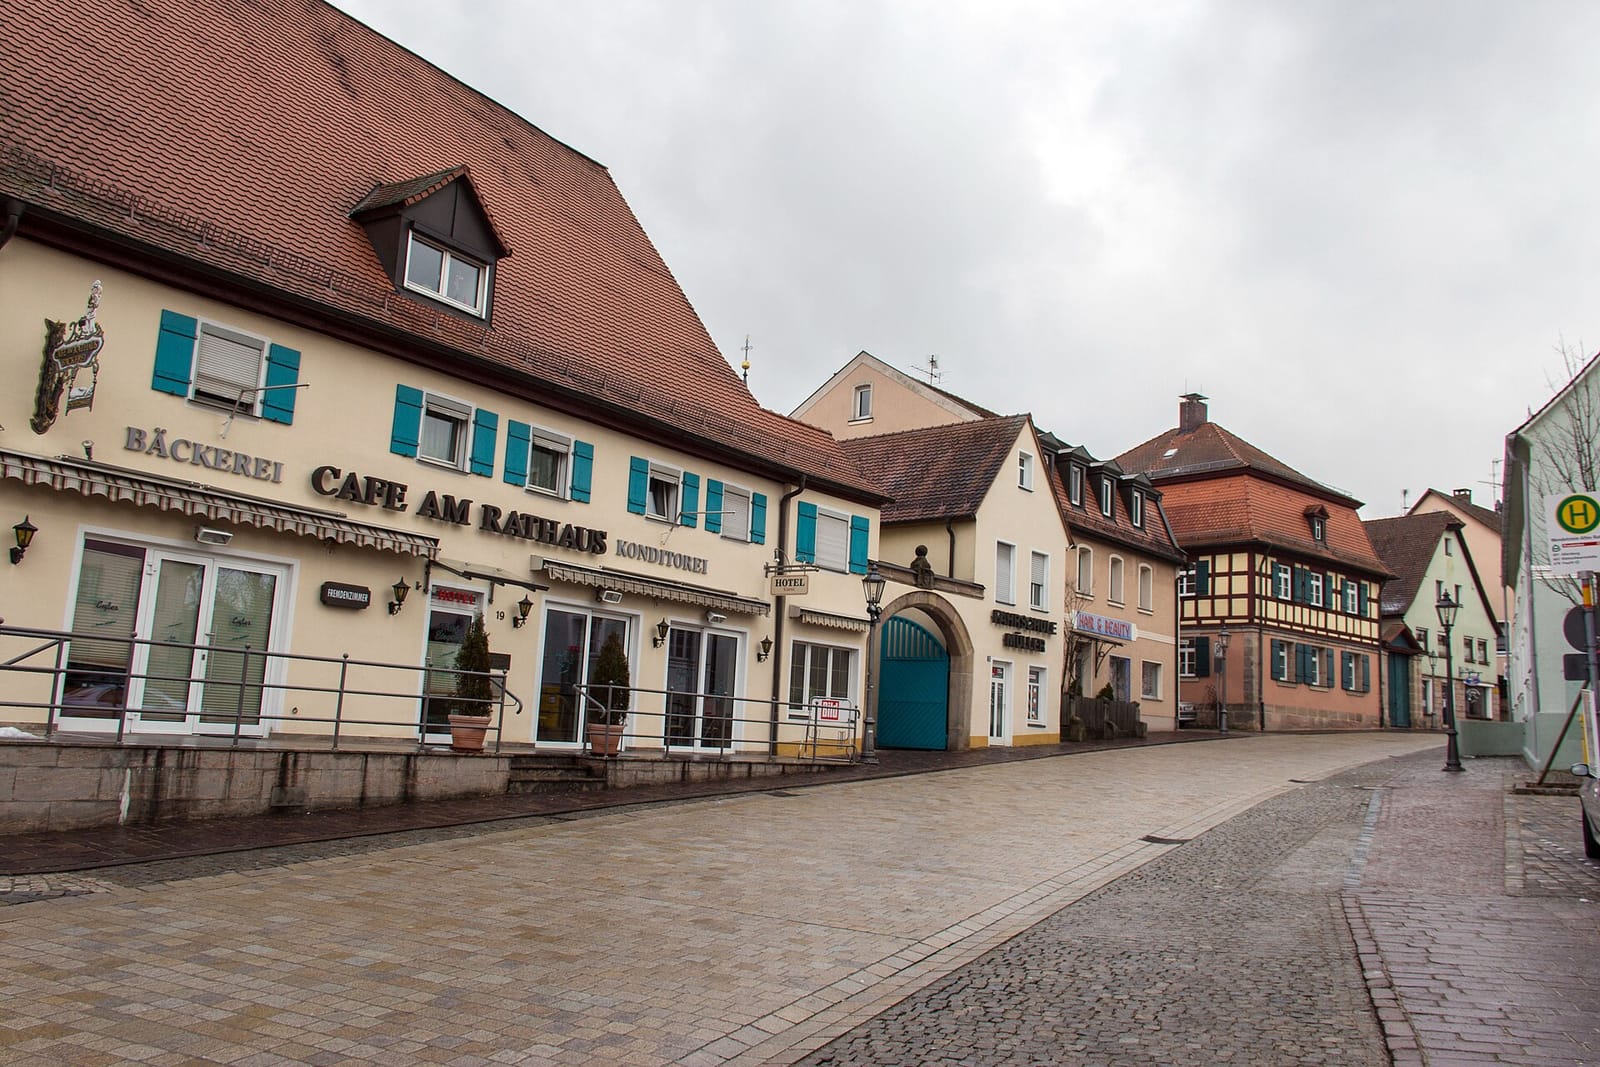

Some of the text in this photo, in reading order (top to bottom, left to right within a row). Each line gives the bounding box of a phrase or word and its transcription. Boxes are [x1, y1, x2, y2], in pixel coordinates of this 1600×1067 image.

[124, 426, 284, 484] BÄCKEREI
[311, 465, 607, 555] CAFE AM RATHAUS
[1569, 503, 1589, 526] H
[616, 539, 709, 575] KONDITOREI
[775, 578, 805, 587] HOTEL
[327, 588, 369, 602] FREMDENZIMMER
[437, 589, 476, 606] HOTEL
[496, 610, 505, 621] 19
[990, 609, 1058, 635] FAHRSCHULE
[1079, 613, 1095, 630] HAIR
[1104, 620, 1130, 637] BEAUTY
[1002, 631, 1046, 653] MÜLLER
[822, 701, 839, 718] Bild
